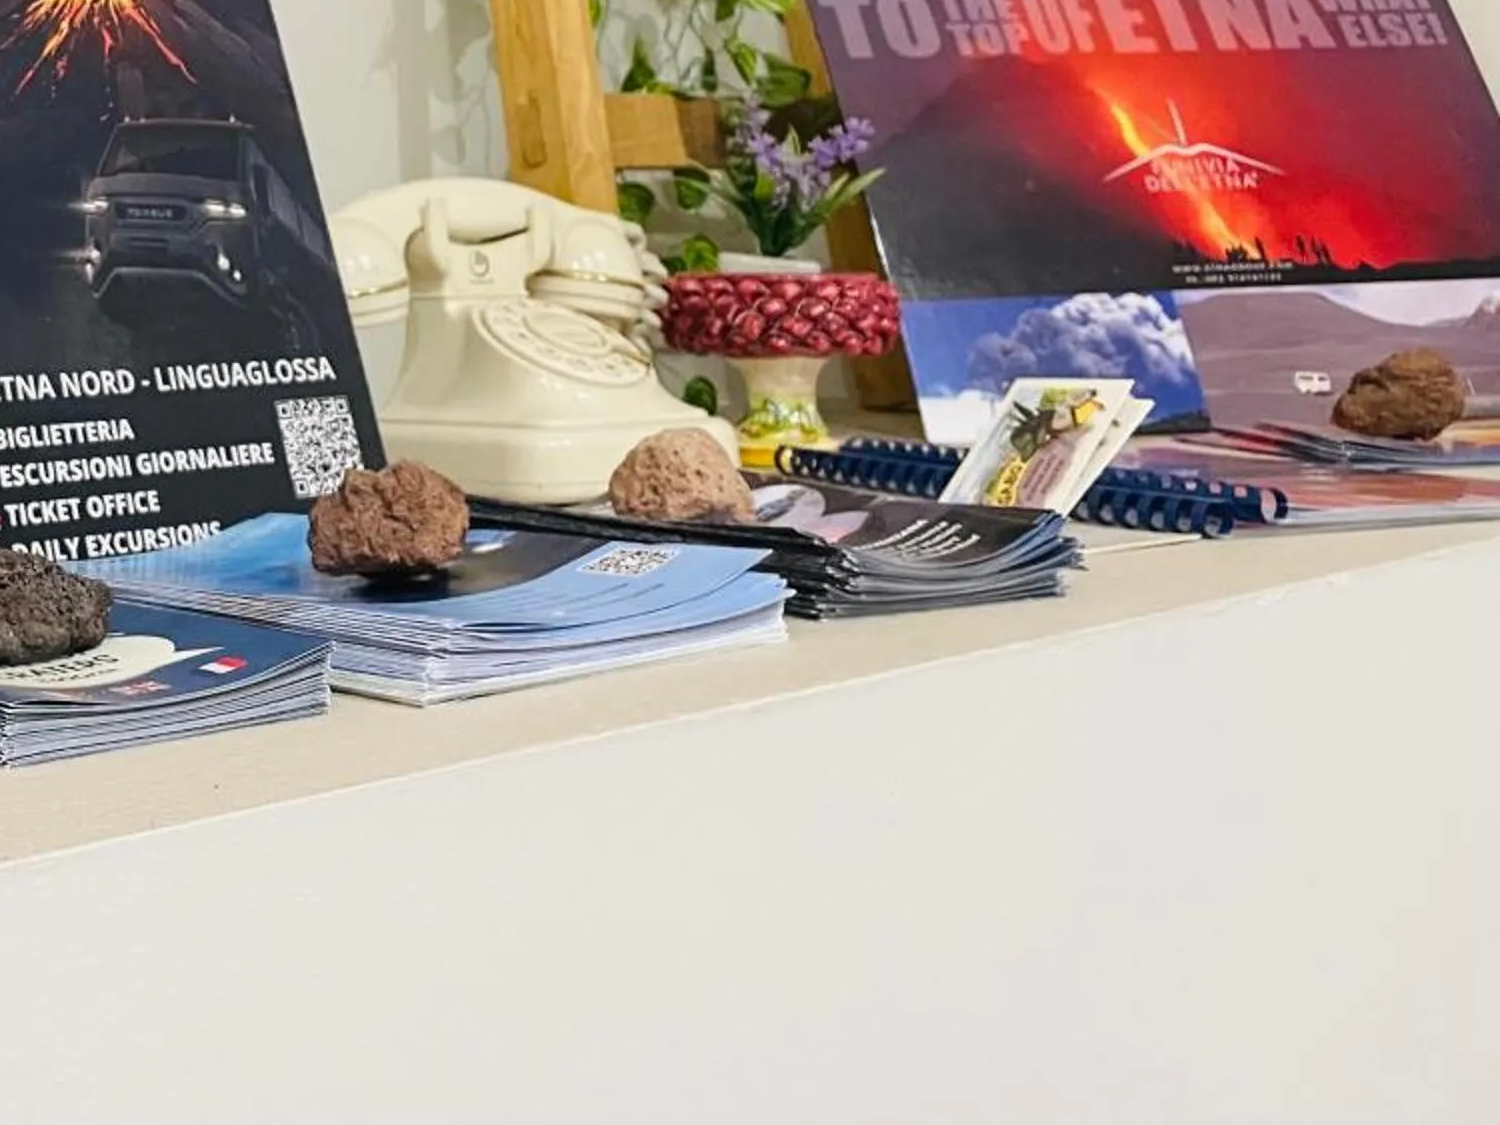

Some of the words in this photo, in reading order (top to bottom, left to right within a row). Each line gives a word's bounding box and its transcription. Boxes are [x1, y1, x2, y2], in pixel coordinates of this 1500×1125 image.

[946, 22, 1029, 56] TOP
[1338, 12, 1449, 49] ELSE!
[60, 369, 136, 400] NORD
[153, 355, 337, 394] LINGUAGLOSSA
[136, 442, 275, 478] GIORNALIERE
[4, 495, 80, 528] TICKET
[86, 490, 161, 520] OFFICE
[85, 521, 221, 559] EXCURSIONS
